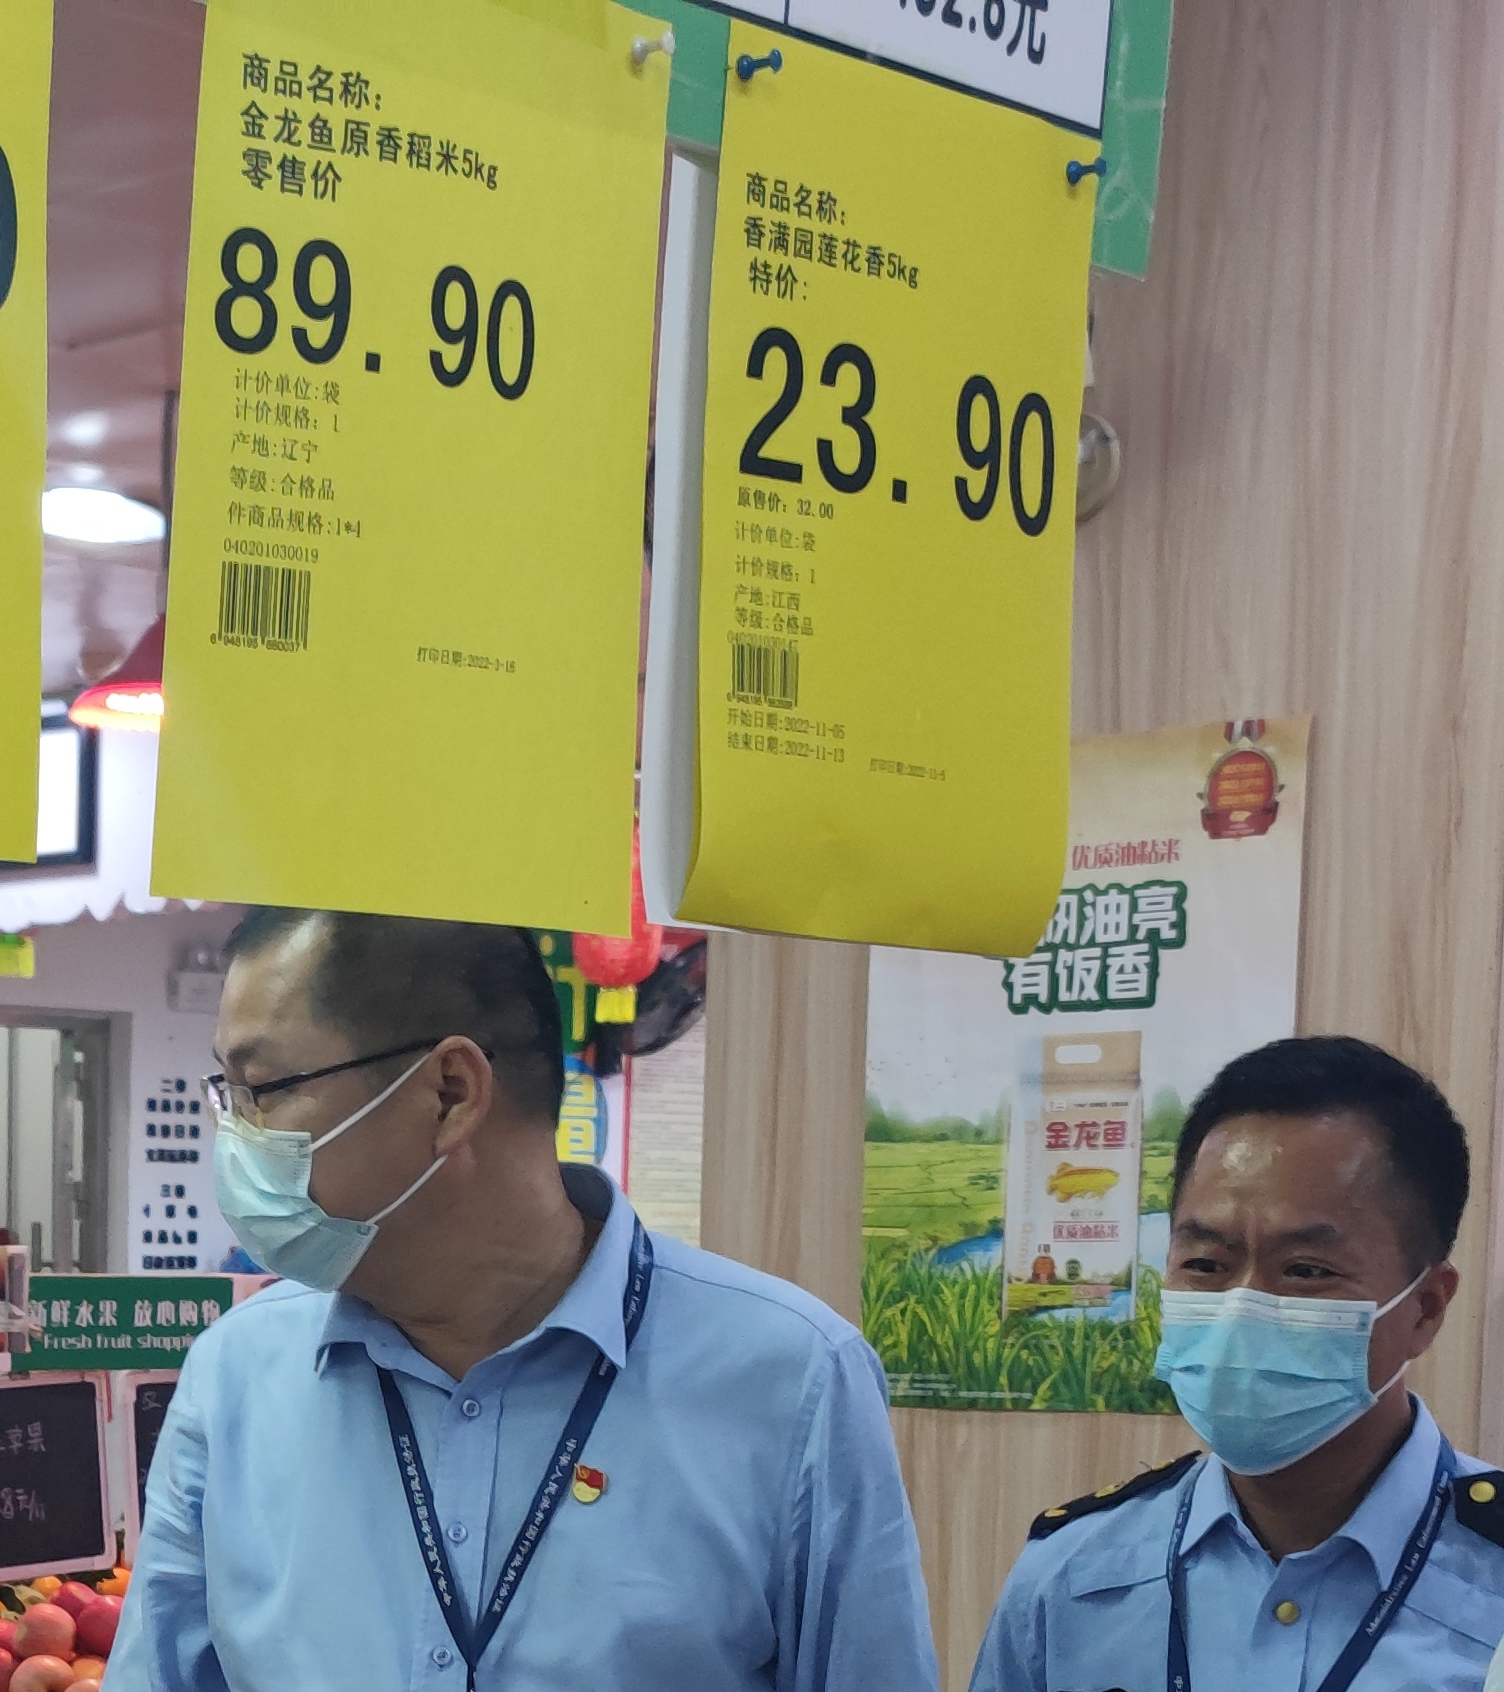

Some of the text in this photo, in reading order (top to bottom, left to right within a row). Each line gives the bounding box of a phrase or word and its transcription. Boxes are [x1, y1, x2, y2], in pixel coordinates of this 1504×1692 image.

[239, 100, 499, 192] 金龙鱼原香稻米5kg
[240, 150, 343, 203] 零售价
[743, 216, 920, 290] 香满园莲花香5kg
[214, 226, 536, 402] 89.90
[739, 326, 1055, 538] 23.90
[1008, 943, 1152, 1005] 有饭香
[1044, 1118, 1129, 1151] 金龙鱼
[43, 1332, 92, 1351] Fresh
[96, 1332, 131, 1351] fruit
